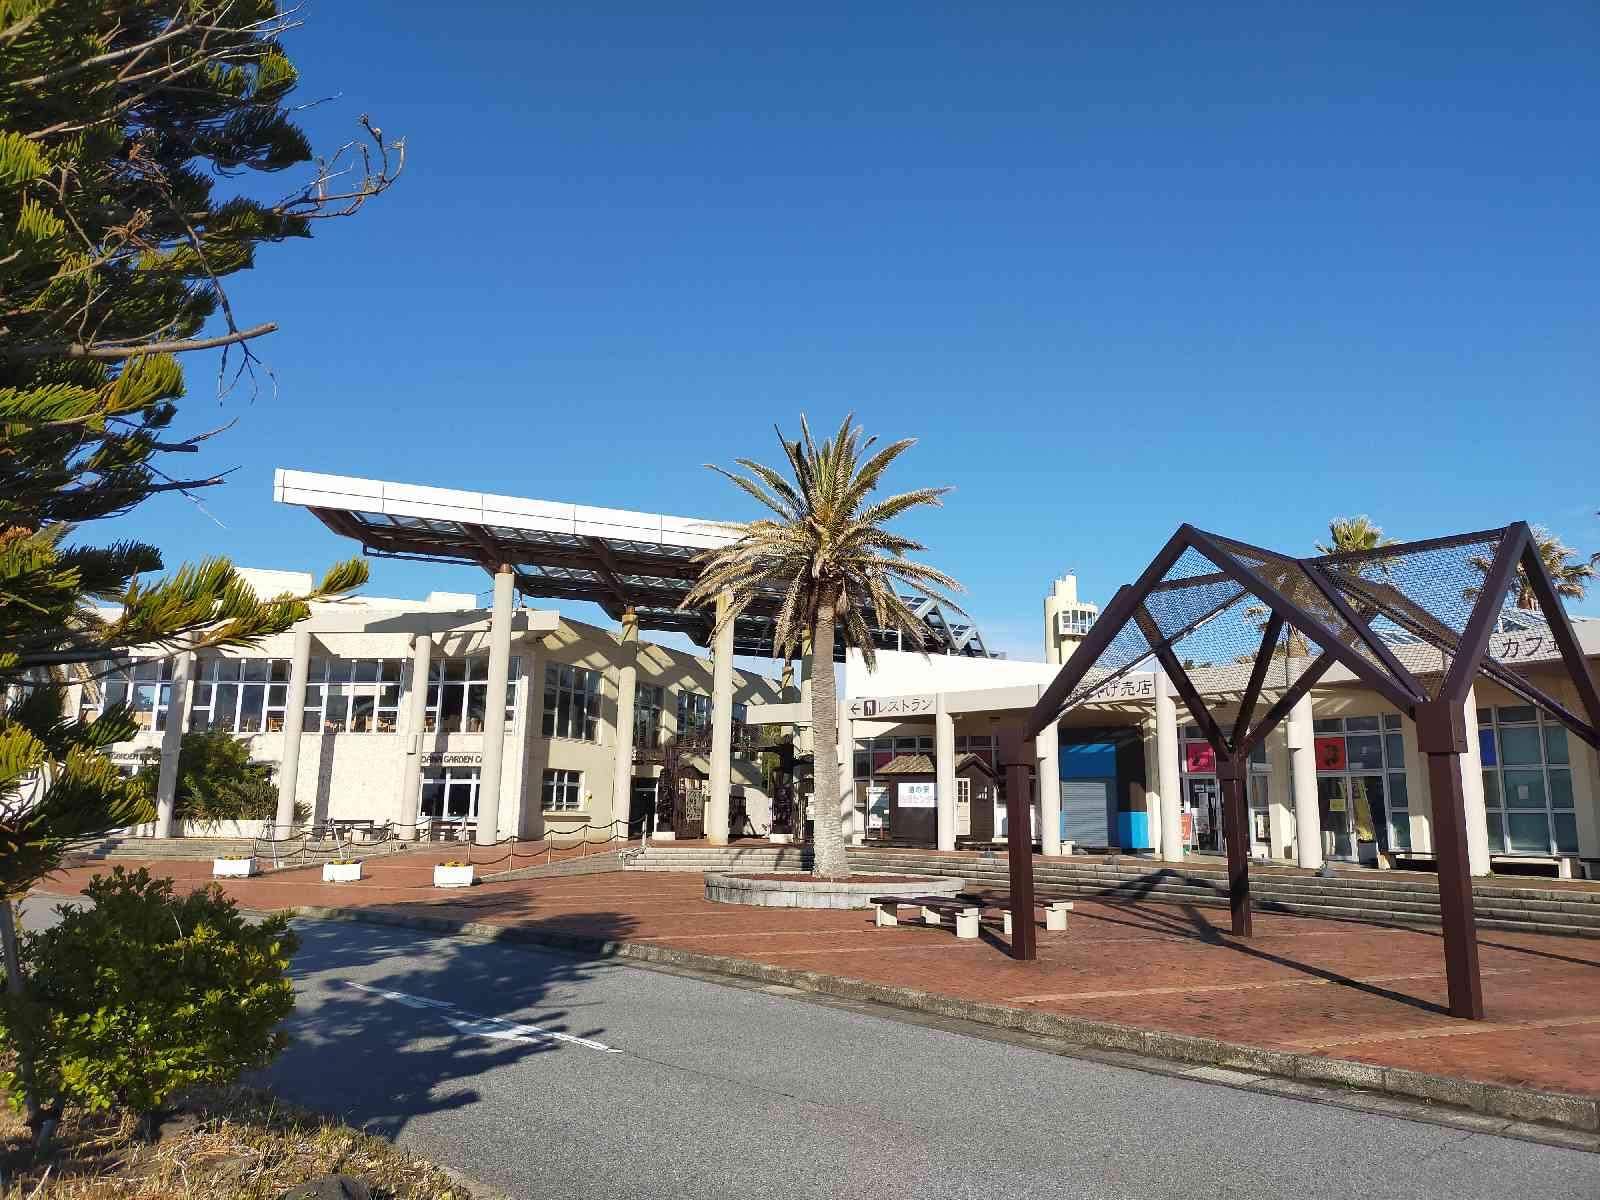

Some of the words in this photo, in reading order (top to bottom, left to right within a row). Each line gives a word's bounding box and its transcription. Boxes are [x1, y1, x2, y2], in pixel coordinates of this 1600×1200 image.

[878, 697, 934, 713] レストラン
[443, 755, 473, 763] GARDEN
